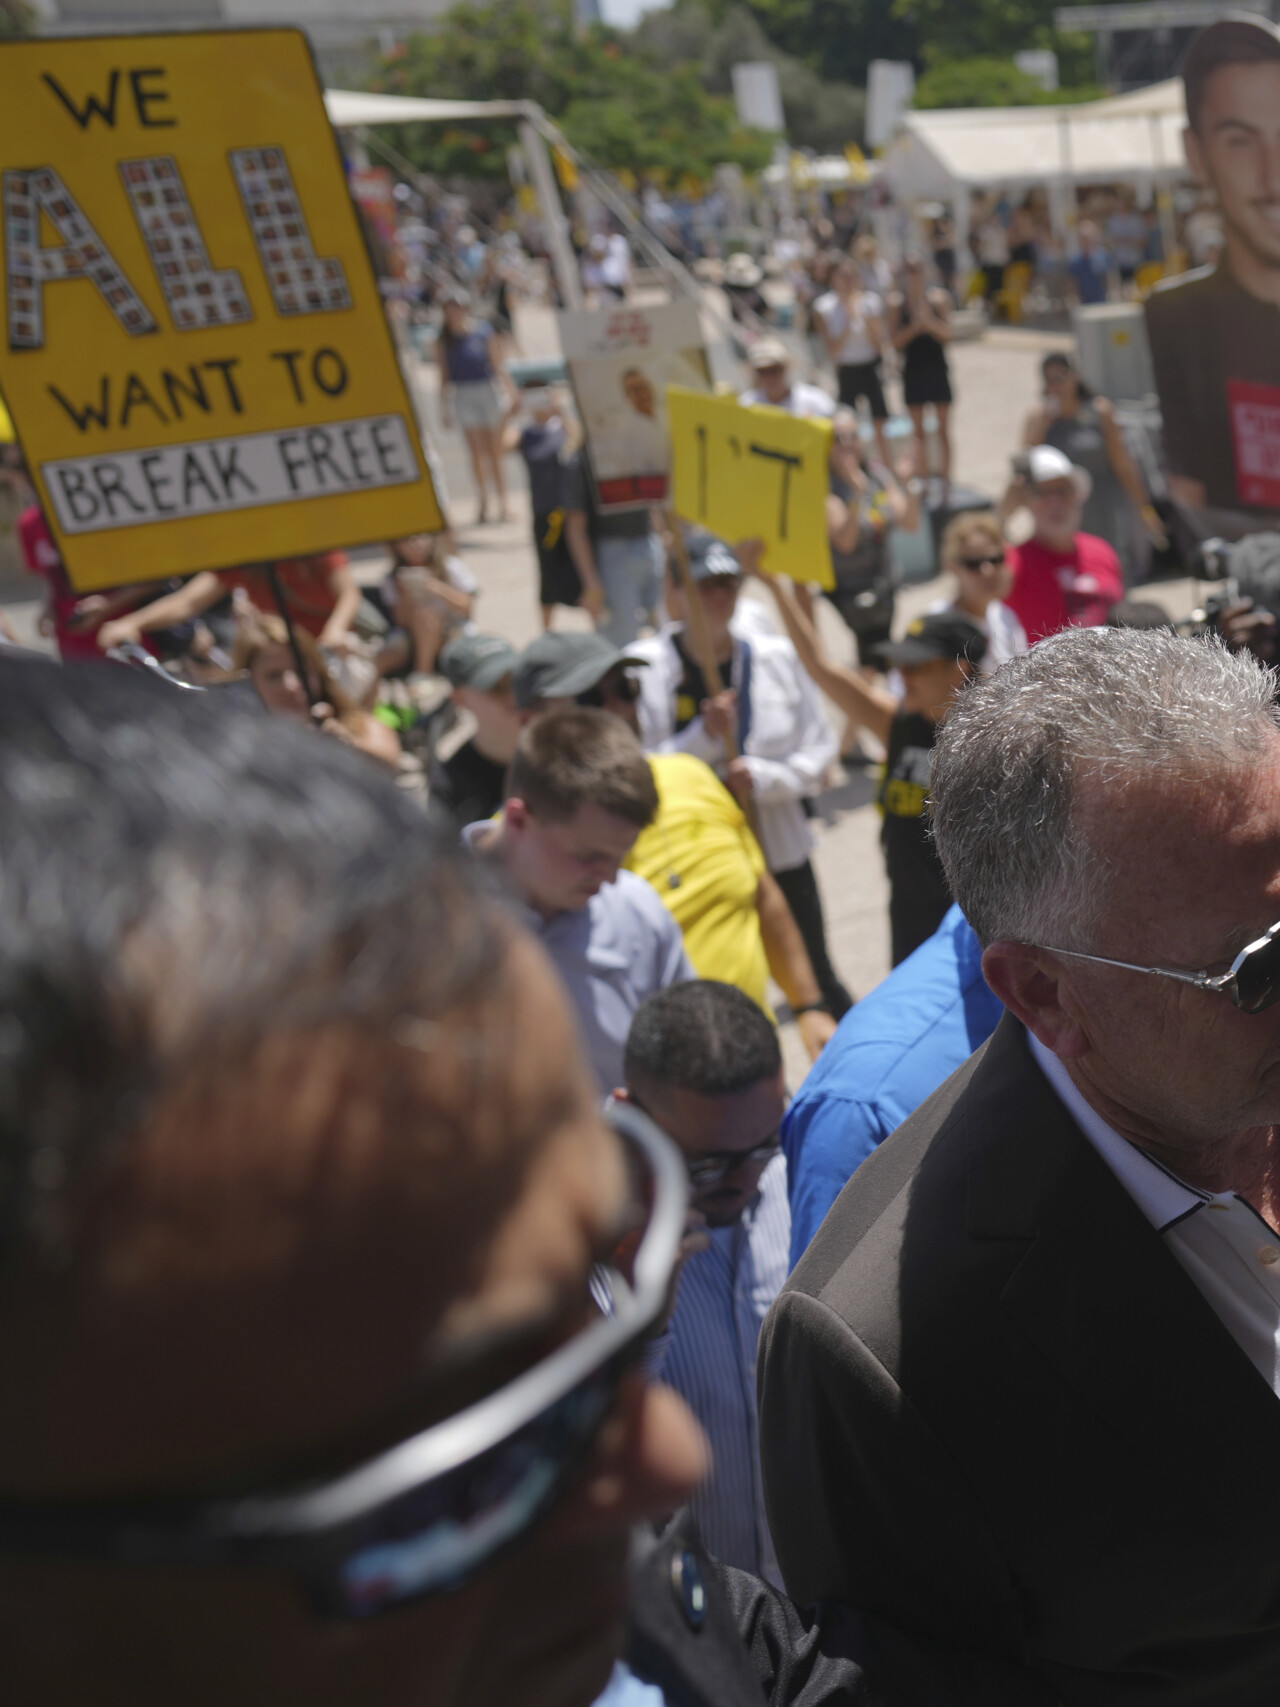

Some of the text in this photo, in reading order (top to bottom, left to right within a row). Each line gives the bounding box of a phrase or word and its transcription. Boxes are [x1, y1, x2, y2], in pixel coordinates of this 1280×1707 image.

[41, 67, 178, 130] WE
[3, 146, 353, 353] ALL
[47, 347, 350, 434] WANT TO
[57, 422, 403, 524] BREAK FREE
